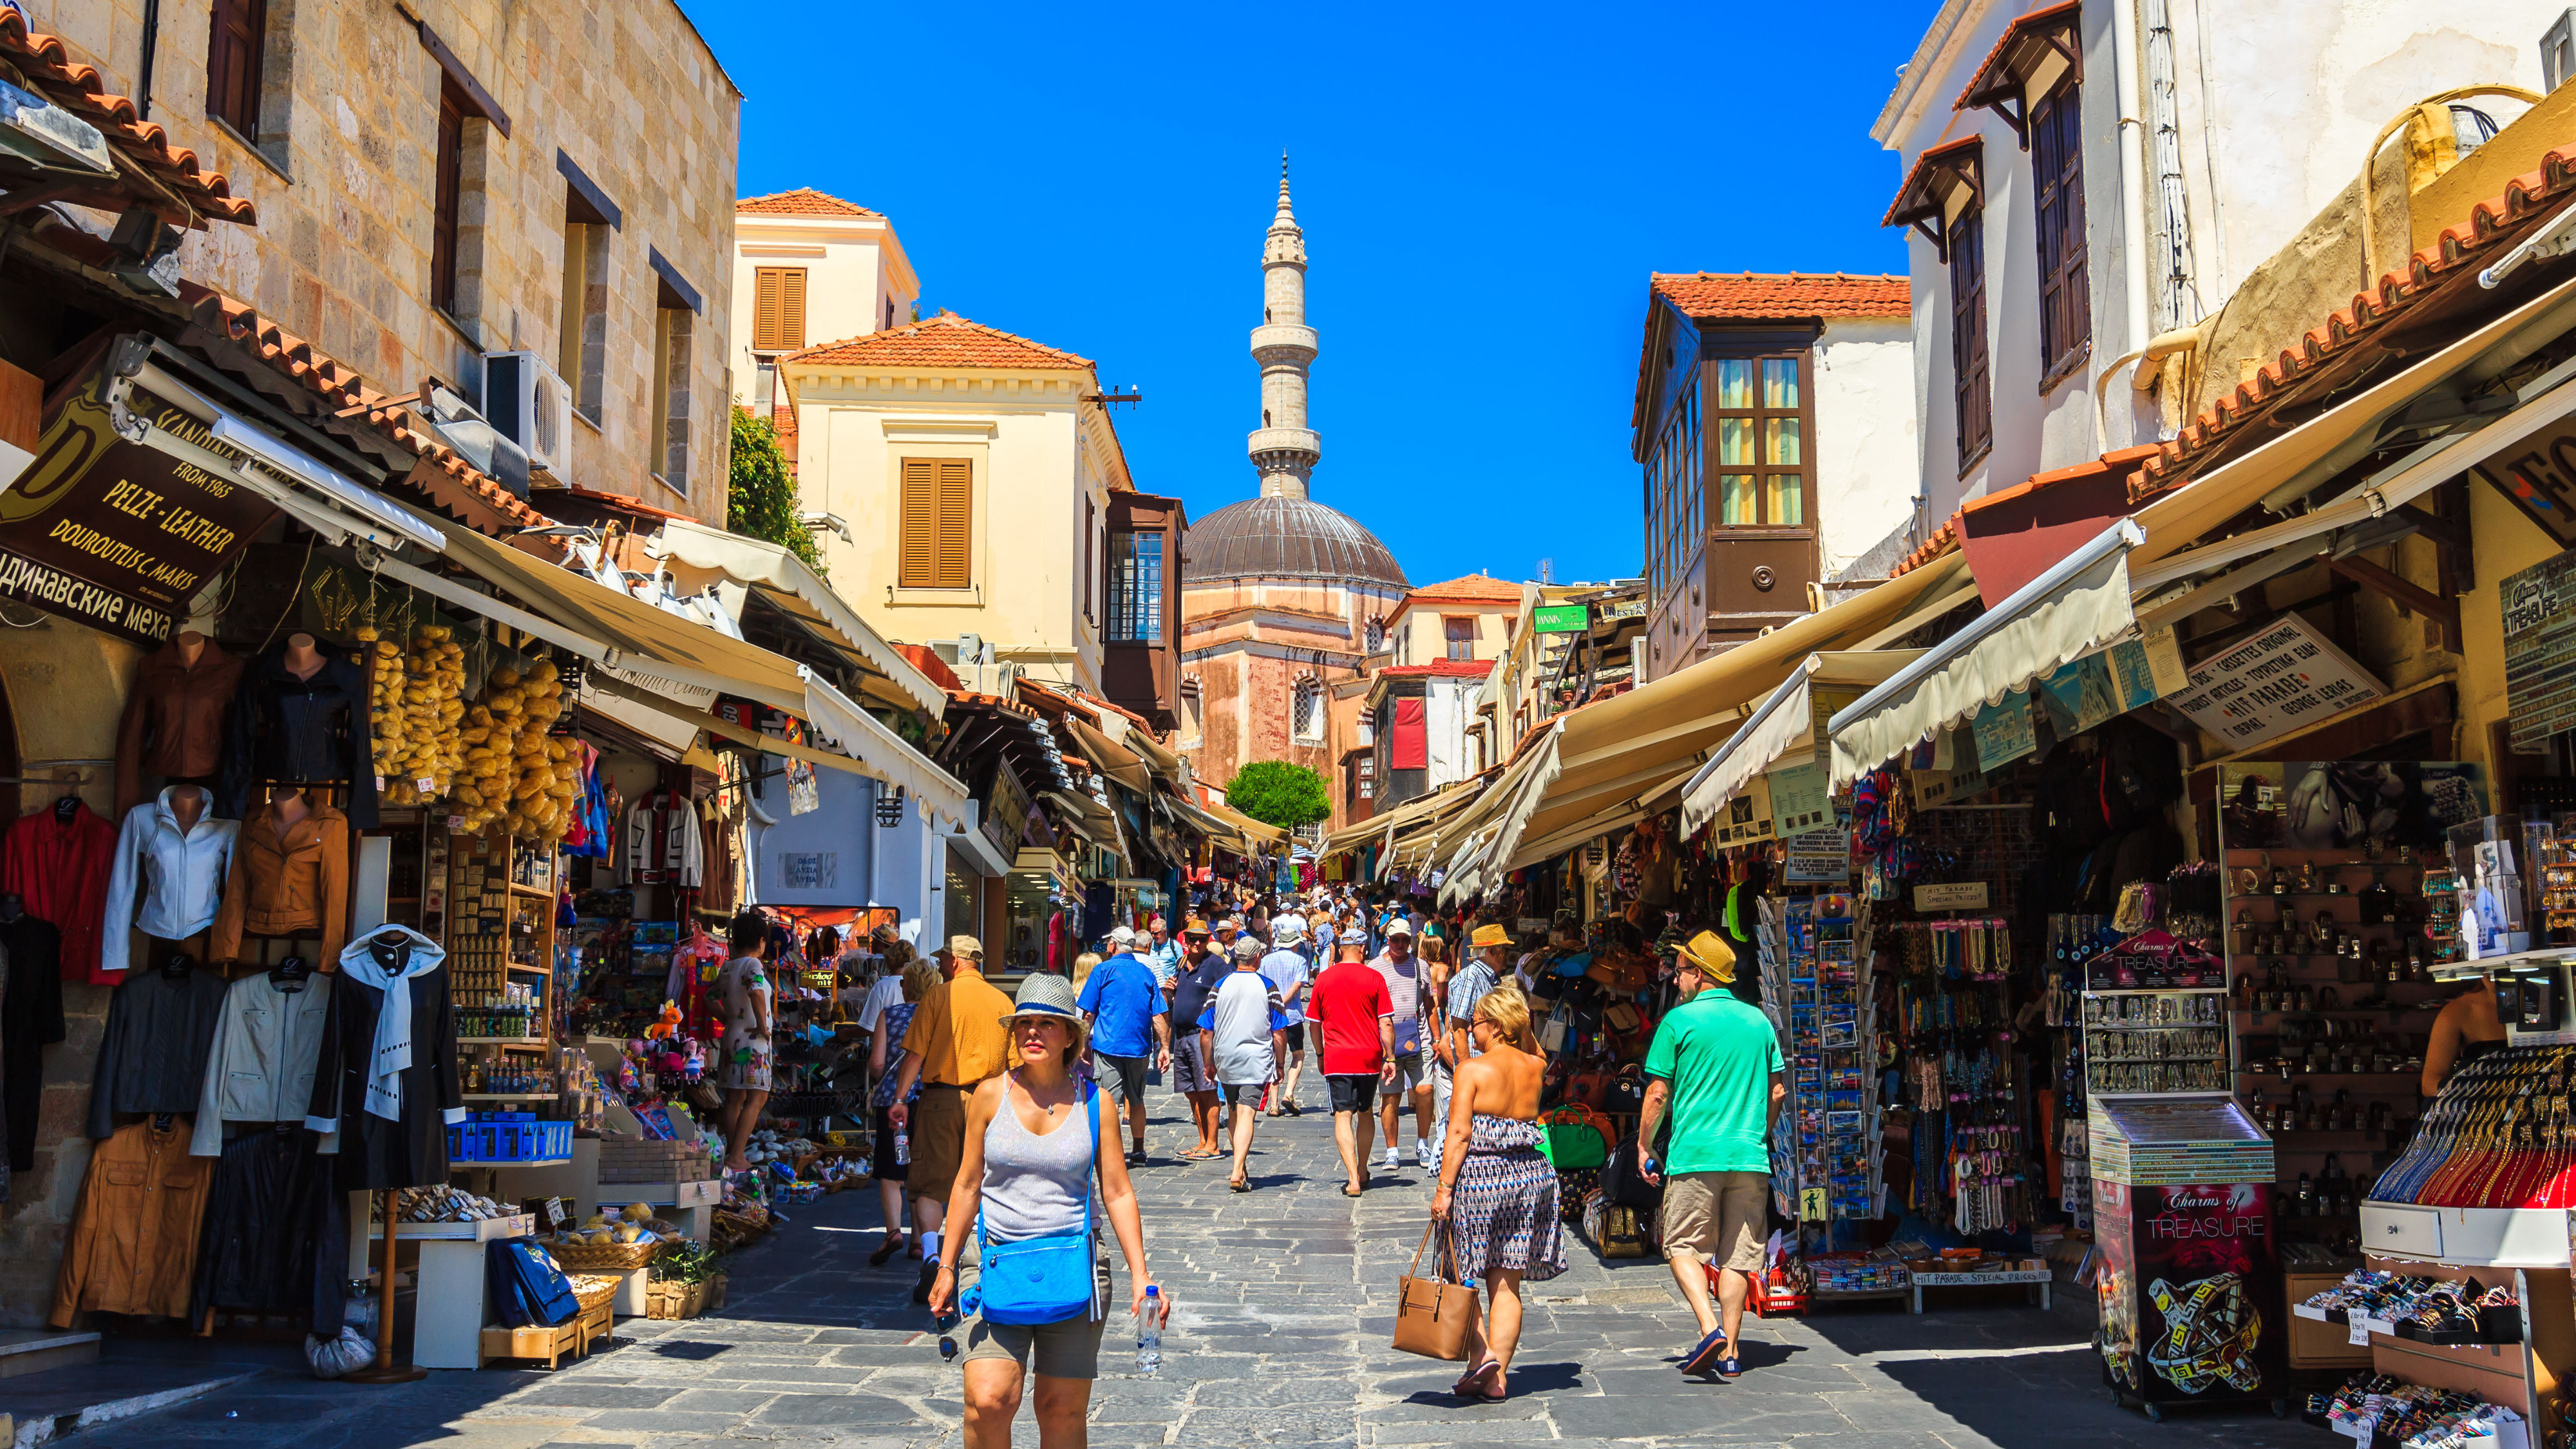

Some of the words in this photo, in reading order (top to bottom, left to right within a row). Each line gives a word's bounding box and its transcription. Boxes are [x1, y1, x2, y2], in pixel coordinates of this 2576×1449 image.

[173, 462, 209, 488] FROM
[205, 478, 232, 498] 1965
[103, 479, 164, 520] PELZE
[160, 506, 235, 554] LEATHER
[49, 518, 146, 568] DOUROUTLIS
[147, 562, 198, 591] MAKIS
[2508, 593, 2559, 632] TREASURE
[2216, 645, 2263, 672] CASSETTES
[2256, 625, 2302, 652] ORIGINAL
[2179, 693, 2214, 715] TOURIST
[2208, 677, 2248, 701] ARTICLES
[2224, 696, 2256, 718] HIT
[2248, 672, 2310, 708] PARADE
[2280, 693, 2322, 715] GEORGE
[2315, 678, 2355, 701] LERIAS
[2116, 956, 2196, 970] TREASURE
[2129, 941, 2164, 953] Charms
[2168, 940, 2179, 953] of
[2161, 1191, 2221, 1213] Charms
[2226, 1190, 2245, 1213] of
[2146, 1216, 2265, 1239] TREASURE
[1917, 1274, 1931, 1283] HIT
[1934, 1273, 1964, 1284] PARADE
[1971, 1273, 2003, 1283] SPECIAL
